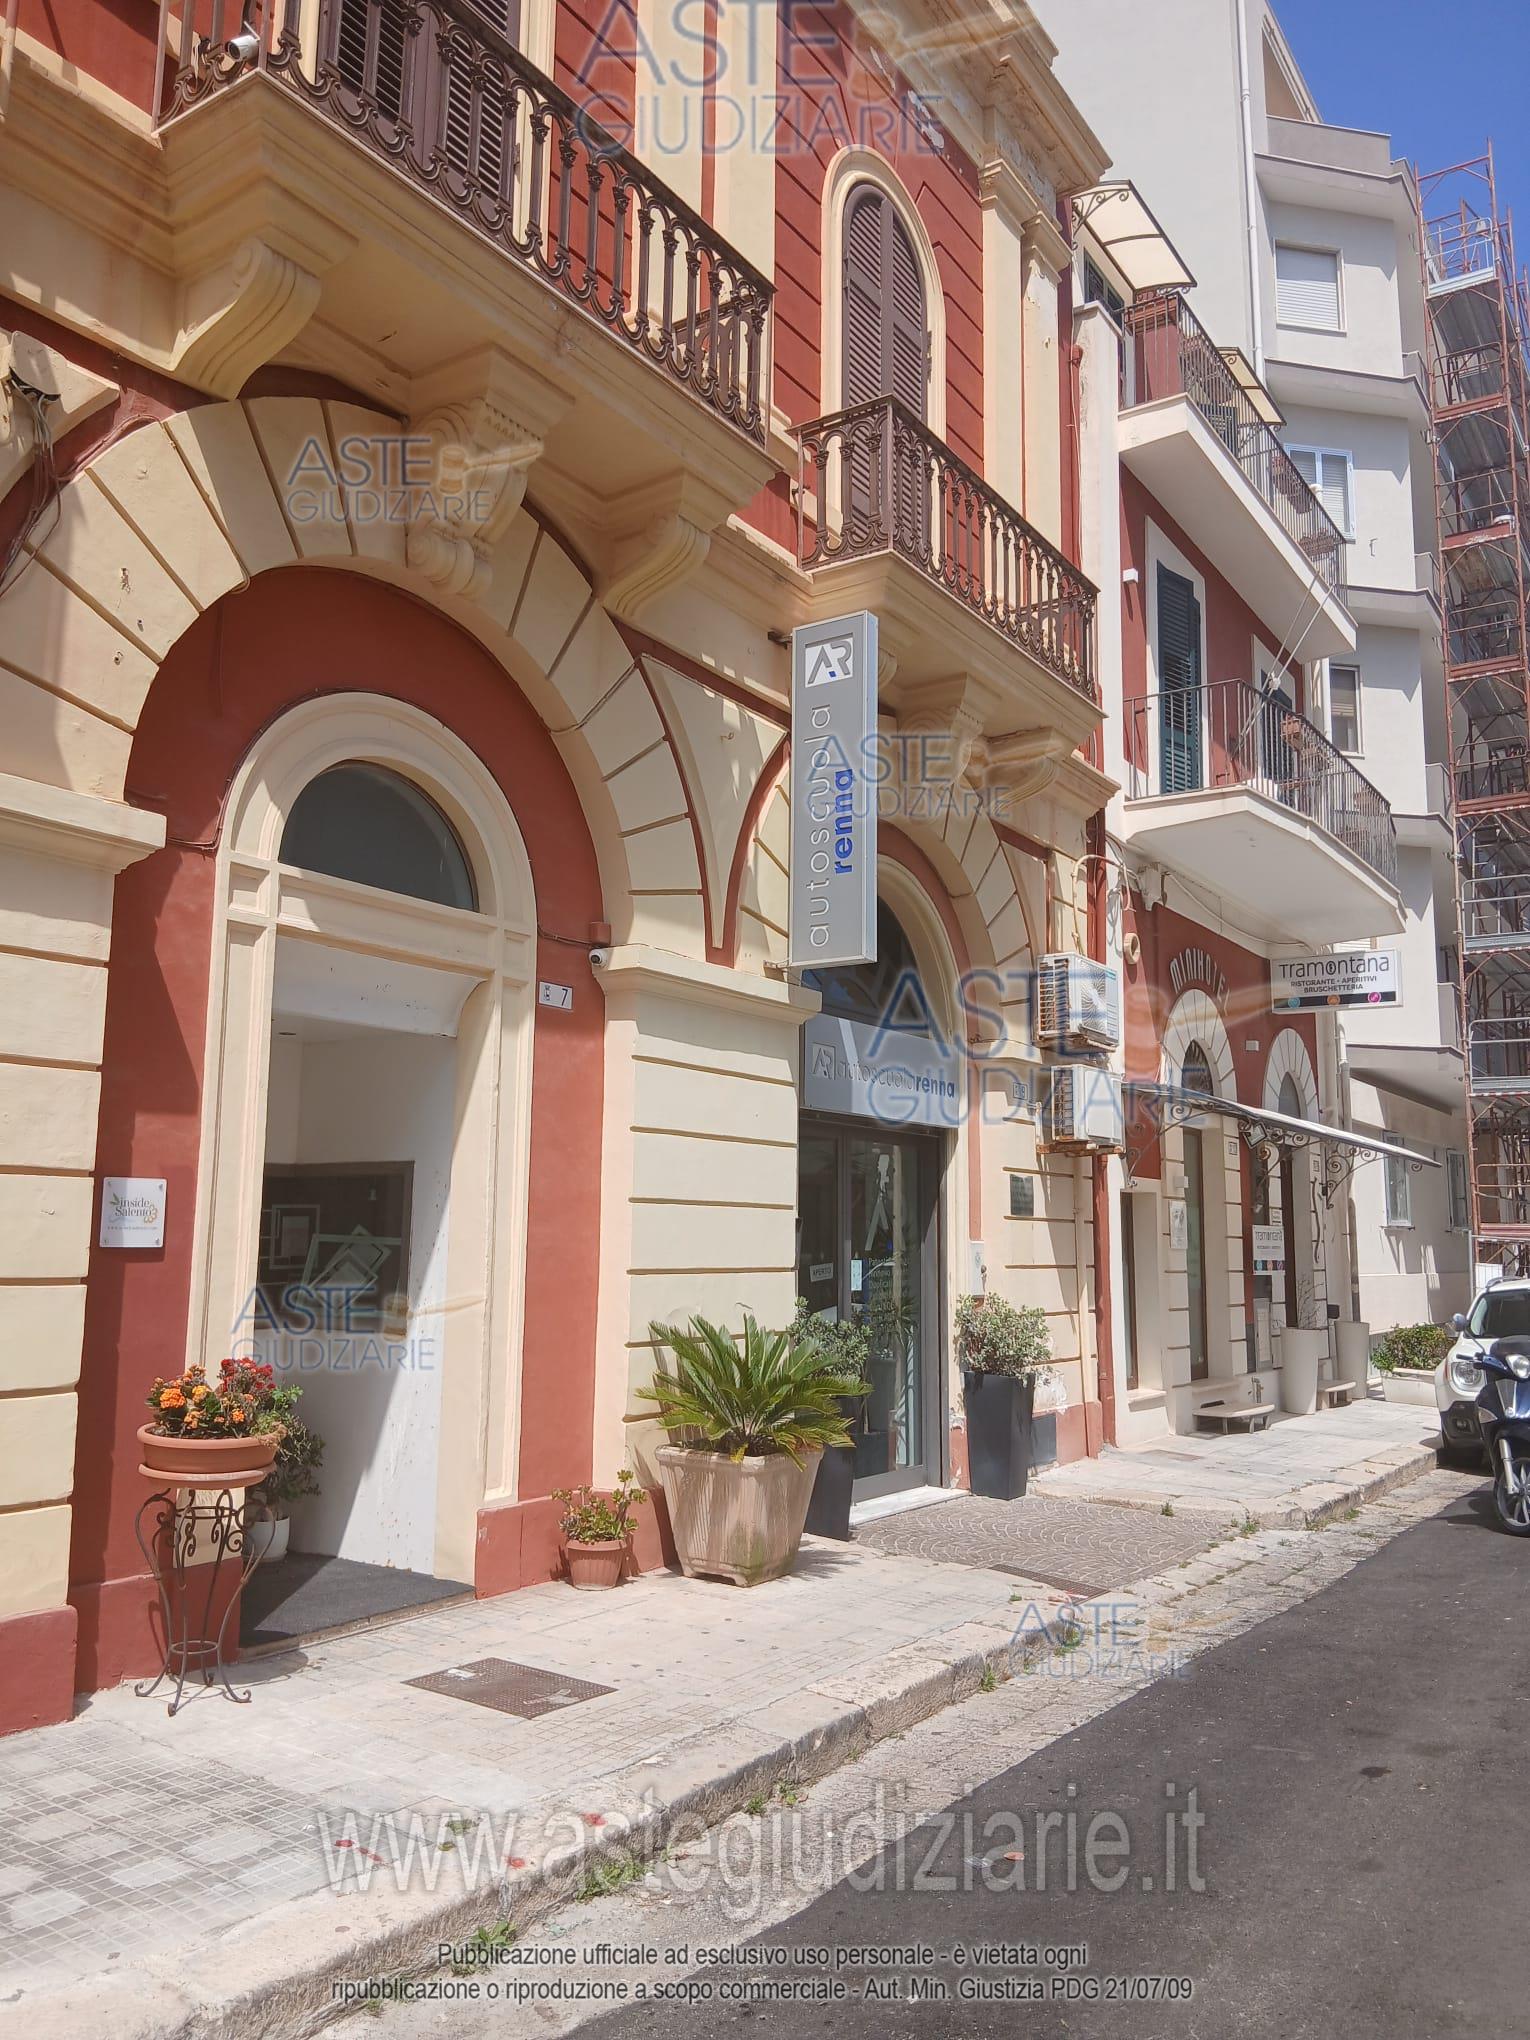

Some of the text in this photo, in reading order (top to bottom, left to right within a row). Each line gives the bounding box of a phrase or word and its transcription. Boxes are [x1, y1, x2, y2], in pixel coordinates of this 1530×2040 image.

[804, 704, 831, 947] autoscuola
[835, 769, 853, 874] renna
[1279, 956, 1390, 979] Tramontana
[1291, 976, 1377, 988] RISTORANTE APERITIVI
[1303, 984, 1364, 993] BRUSCHETTERIA
[562, 988, 568, 1006] 7
[120, 1196, 150, 1208] inside
[115, 1206, 152, 1217] Salento
